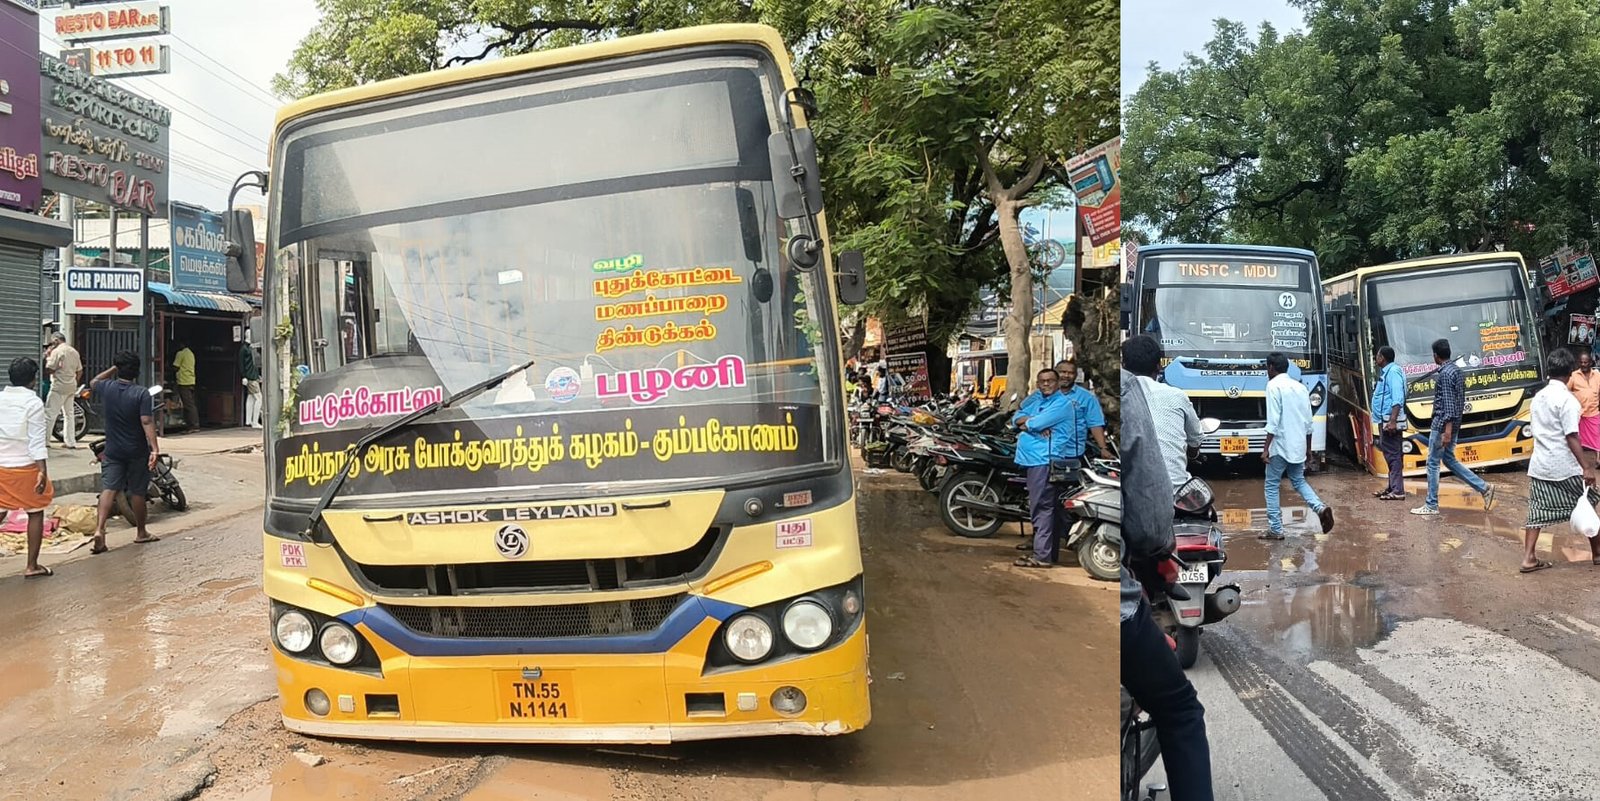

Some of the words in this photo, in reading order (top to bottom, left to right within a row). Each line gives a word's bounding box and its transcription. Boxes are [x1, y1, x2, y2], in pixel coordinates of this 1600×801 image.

[55, 12, 105, 34] RESTO
[108, 9, 140, 29] BAR
[114, 48, 136, 65] TO
[69, 91, 124, 131] SPORTS
[49, 151, 109, 187] RESTO
[110, 169, 158, 214] BAR
[592, 253, 643, 272] வழி
[1178, 263, 1229, 277] TNSTC
[1244, 264, 1278, 278] MDU
[69, 272, 92, 289] CAR
[93, 272, 140, 290] PARKING
[593, 267, 742, 298] புதுக்கோட்டை
[595, 294, 728, 321] மணப்பாறை
[1282, 295, 1293, 308] 23
[595, 319, 717, 353] திண்டுக்கல்
[595, 354, 747, 404] பழனி
[364, 444, 410, 475] அரசு
[414, 423, 565, 473] போக்குவரத்துக்
[568, 417, 638, 470] கழகம்
[652, 412, 799, 462] கும்பகோணம்
[410, 510, 489, 525] ASHOK
[502, 504, 615, 521] LEYLAND
[781, 522, 806, 535] புது
[281, 543, 302, 557] PDK
[285, 557, 302, 566] PTK
[513, 682, 560, 699] TN.55
[510, 702, 567, 719] N.1141
